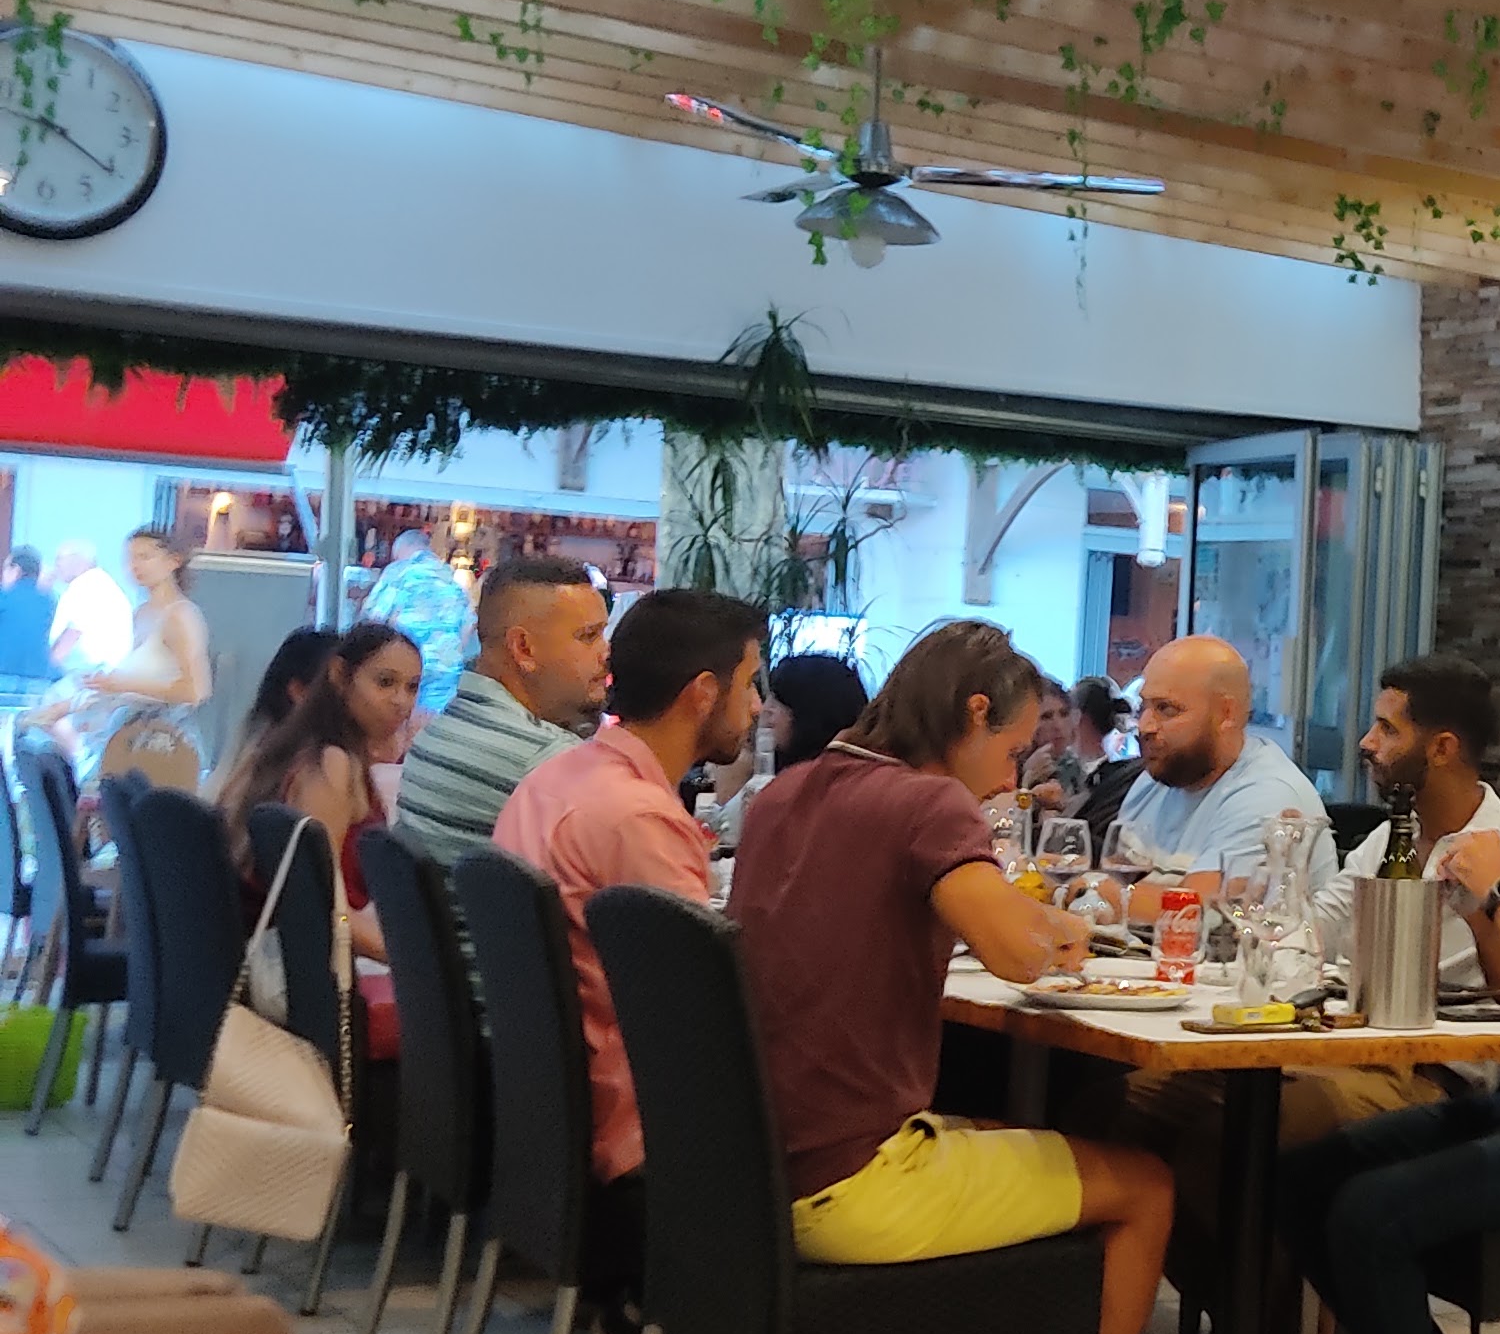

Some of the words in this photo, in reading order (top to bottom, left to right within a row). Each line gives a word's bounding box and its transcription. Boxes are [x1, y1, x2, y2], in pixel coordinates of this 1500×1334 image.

[105, 91, 120, 113] 2
[119, 125, 132, 149] 3
[37, 177, 55, 201] 6
[79, 173, 92, 199] 5
